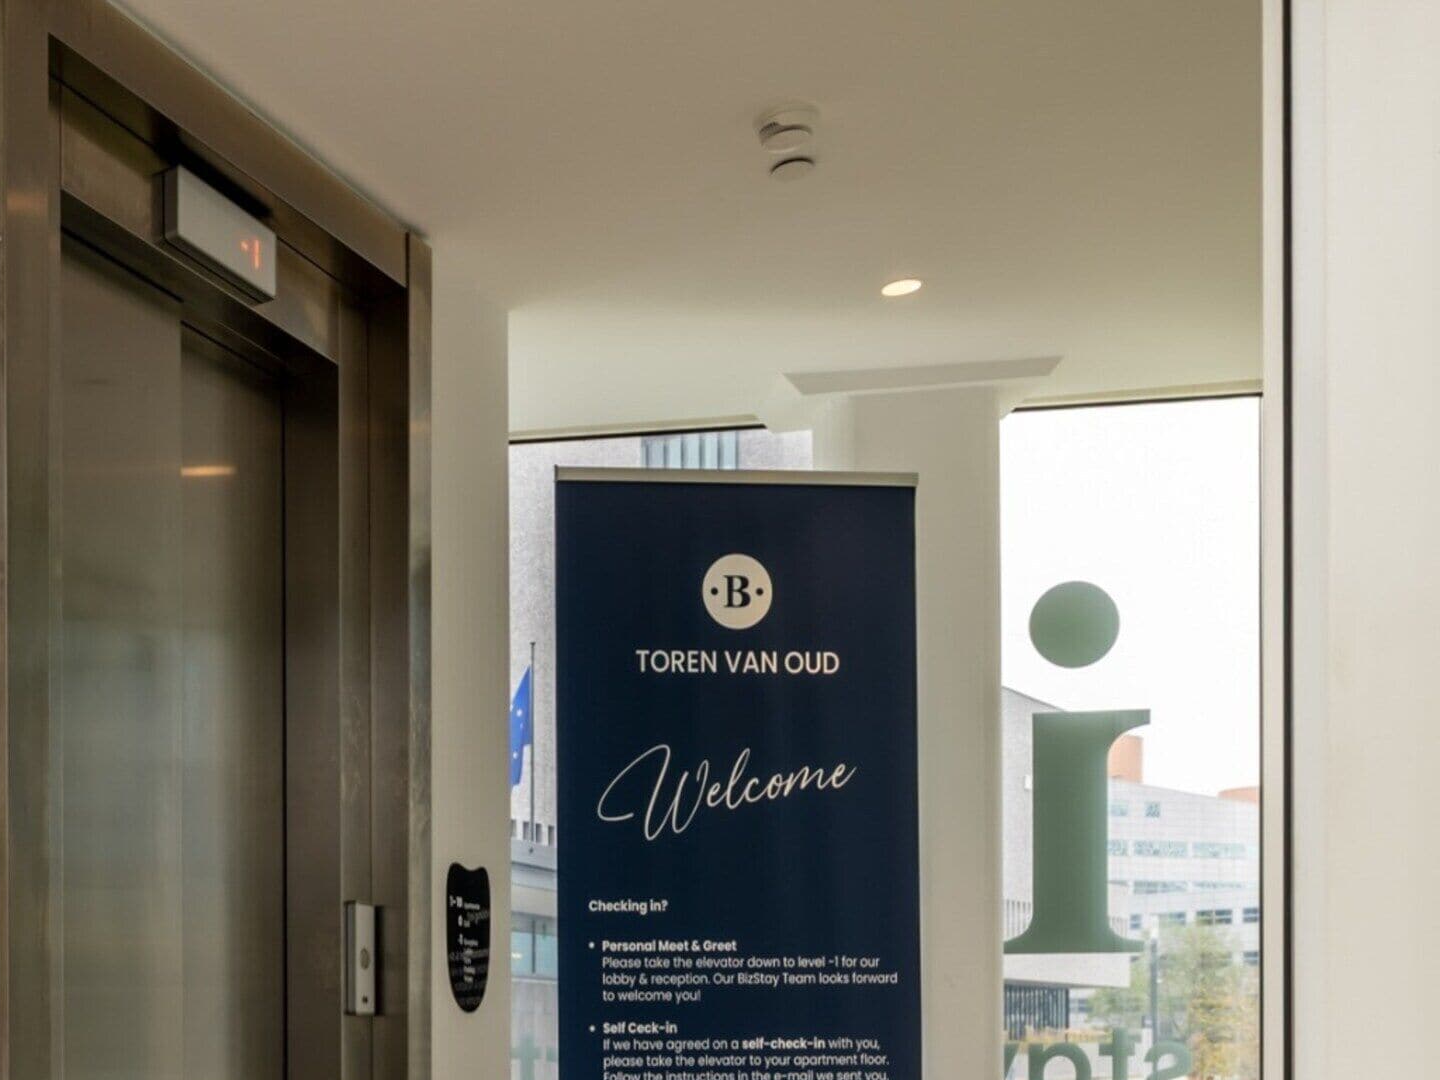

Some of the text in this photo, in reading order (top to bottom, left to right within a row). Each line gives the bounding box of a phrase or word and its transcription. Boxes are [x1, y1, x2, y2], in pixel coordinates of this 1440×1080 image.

[635, 649, 840, 675] TOREN VAN OUD
[597, 743, 857, 842] Welcome
[588, 898, 669, 916] Checking in?
[601, 939, 738, 953] Personal Meet & Greet
[601, 956, 642, 969] Please
[643, 956, 671, 969] take
[672, 956, 693, 969] the
[695, 955, 745, 970] elevator
[746, 956, 781, 969] down
[782, 956, 796, 969] to
[797, 955, 826, 969] level
[841, 954, 858, 968] for
[859, 957, 881, 969] our
[602, 970, 898, 988] lobby & reception. Our BizStay Team looks forward
[602, 988, 702, 1005] to welcome you!
[602, 1020, 678, 1035] Self Ceck-in
[602, 1036, 881, 1054] If we have agreed on a self-check-in with you,
[602, 1052, 890, 1070] please take the elevator to your apartment floor.
